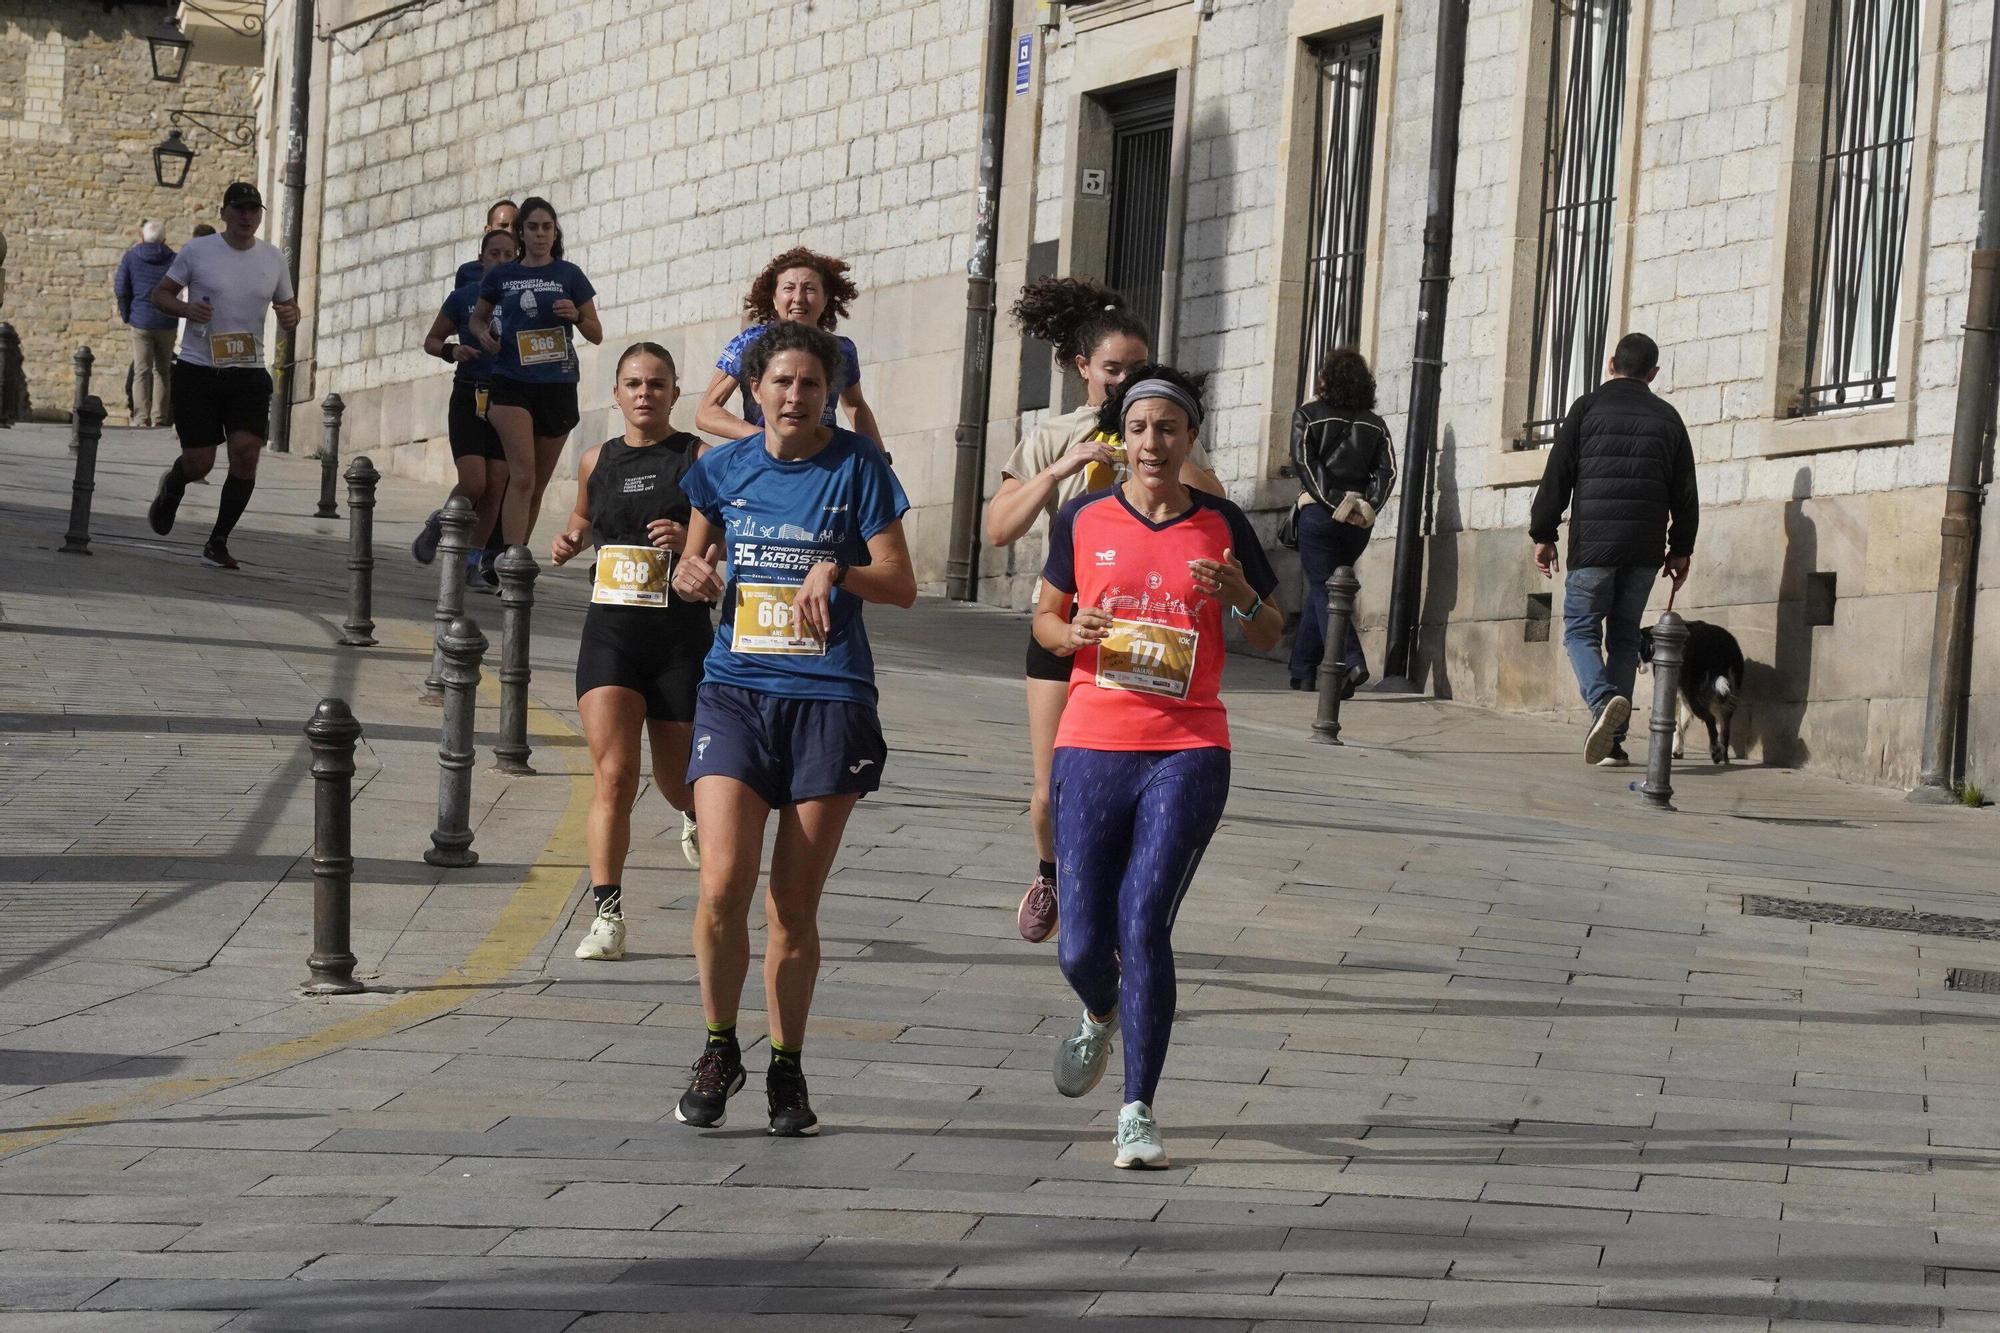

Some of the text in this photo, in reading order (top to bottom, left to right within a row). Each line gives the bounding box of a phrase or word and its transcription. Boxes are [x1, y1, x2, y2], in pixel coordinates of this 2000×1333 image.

[510, 278, 543, 286] CONQUISTA
[510, 280, 555, 290] ALMENDRA
[225, 340, 244, 353] 178
[531, 336, 554, 351] 366
[612, 561, 649, 584] 438
[759, 562, 790, 570] CROSS
[1129, 639, 1165, 668] 177
